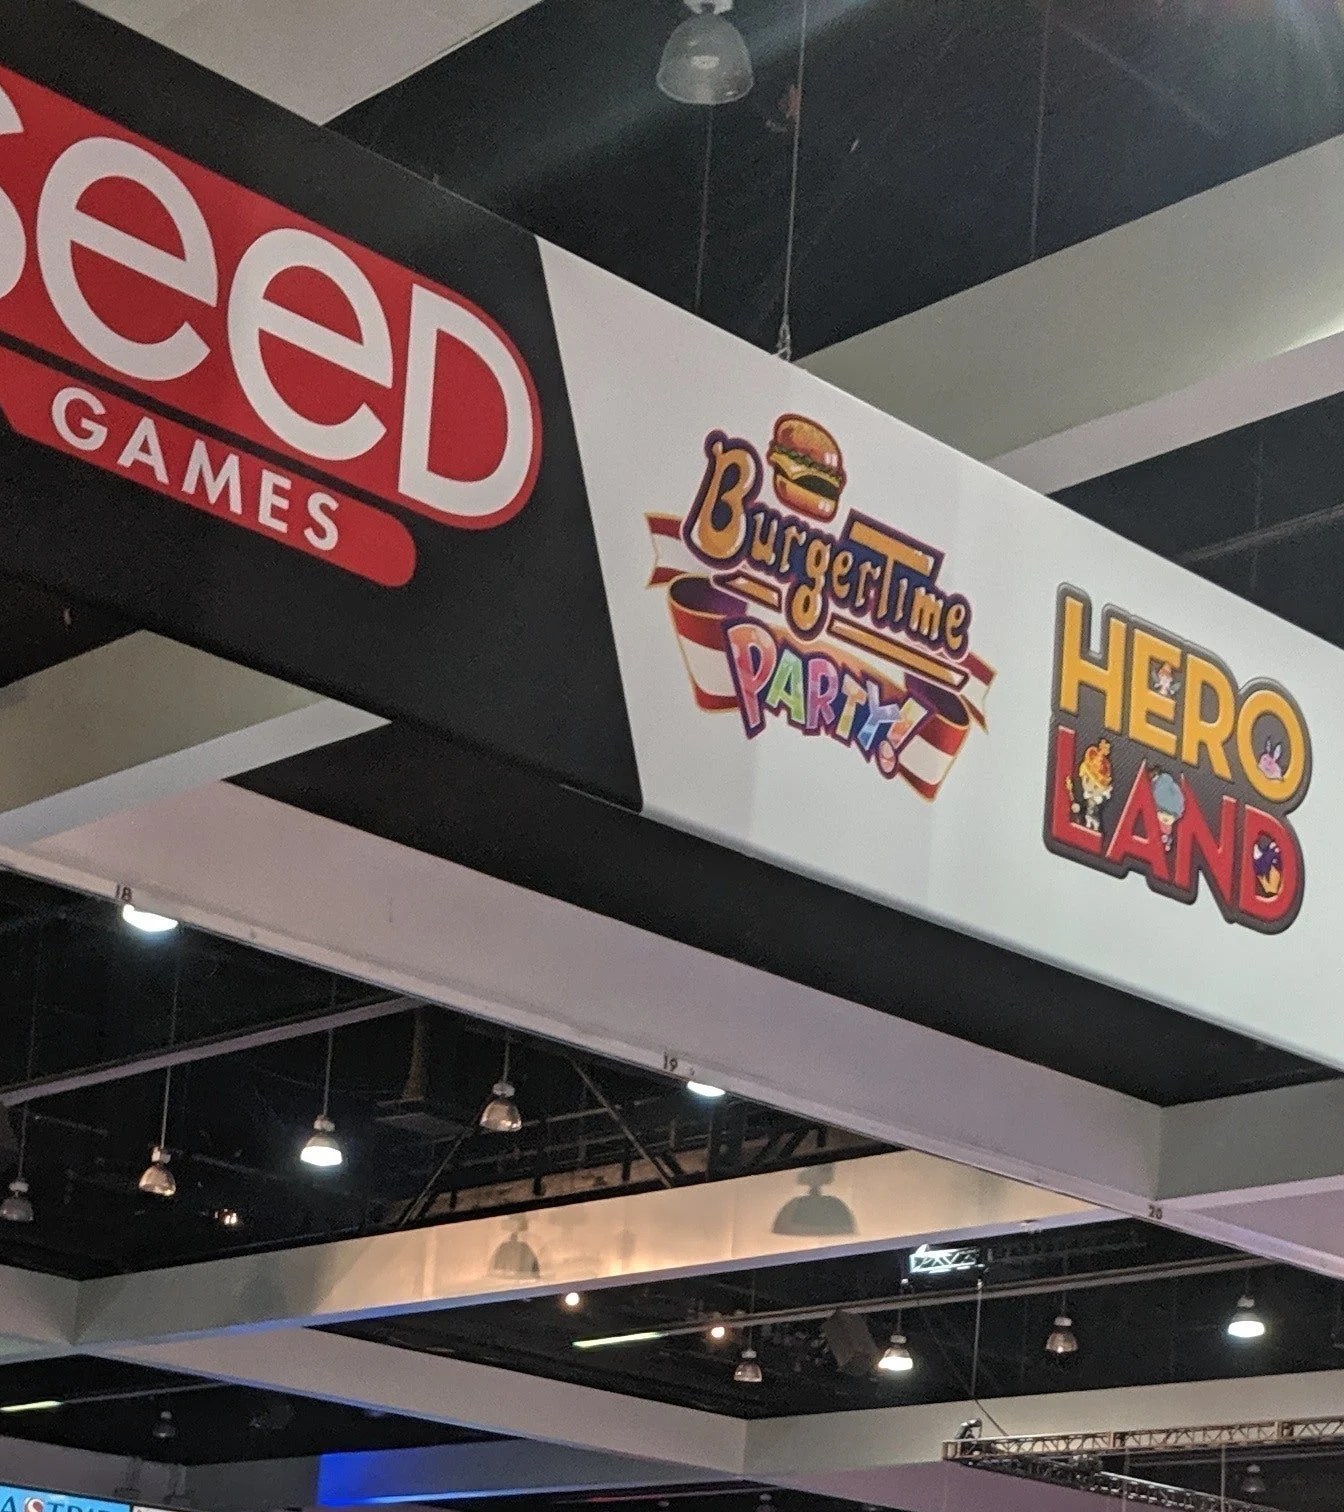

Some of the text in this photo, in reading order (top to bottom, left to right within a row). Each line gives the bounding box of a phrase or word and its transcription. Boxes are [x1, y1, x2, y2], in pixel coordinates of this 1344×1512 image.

[50, 387, 340, 553] GAMES
[726, 621, 931, 778] PARTY!
[1058, 595, 1308, 802] HERO
[1049, 724, 1301, 922] LAND
